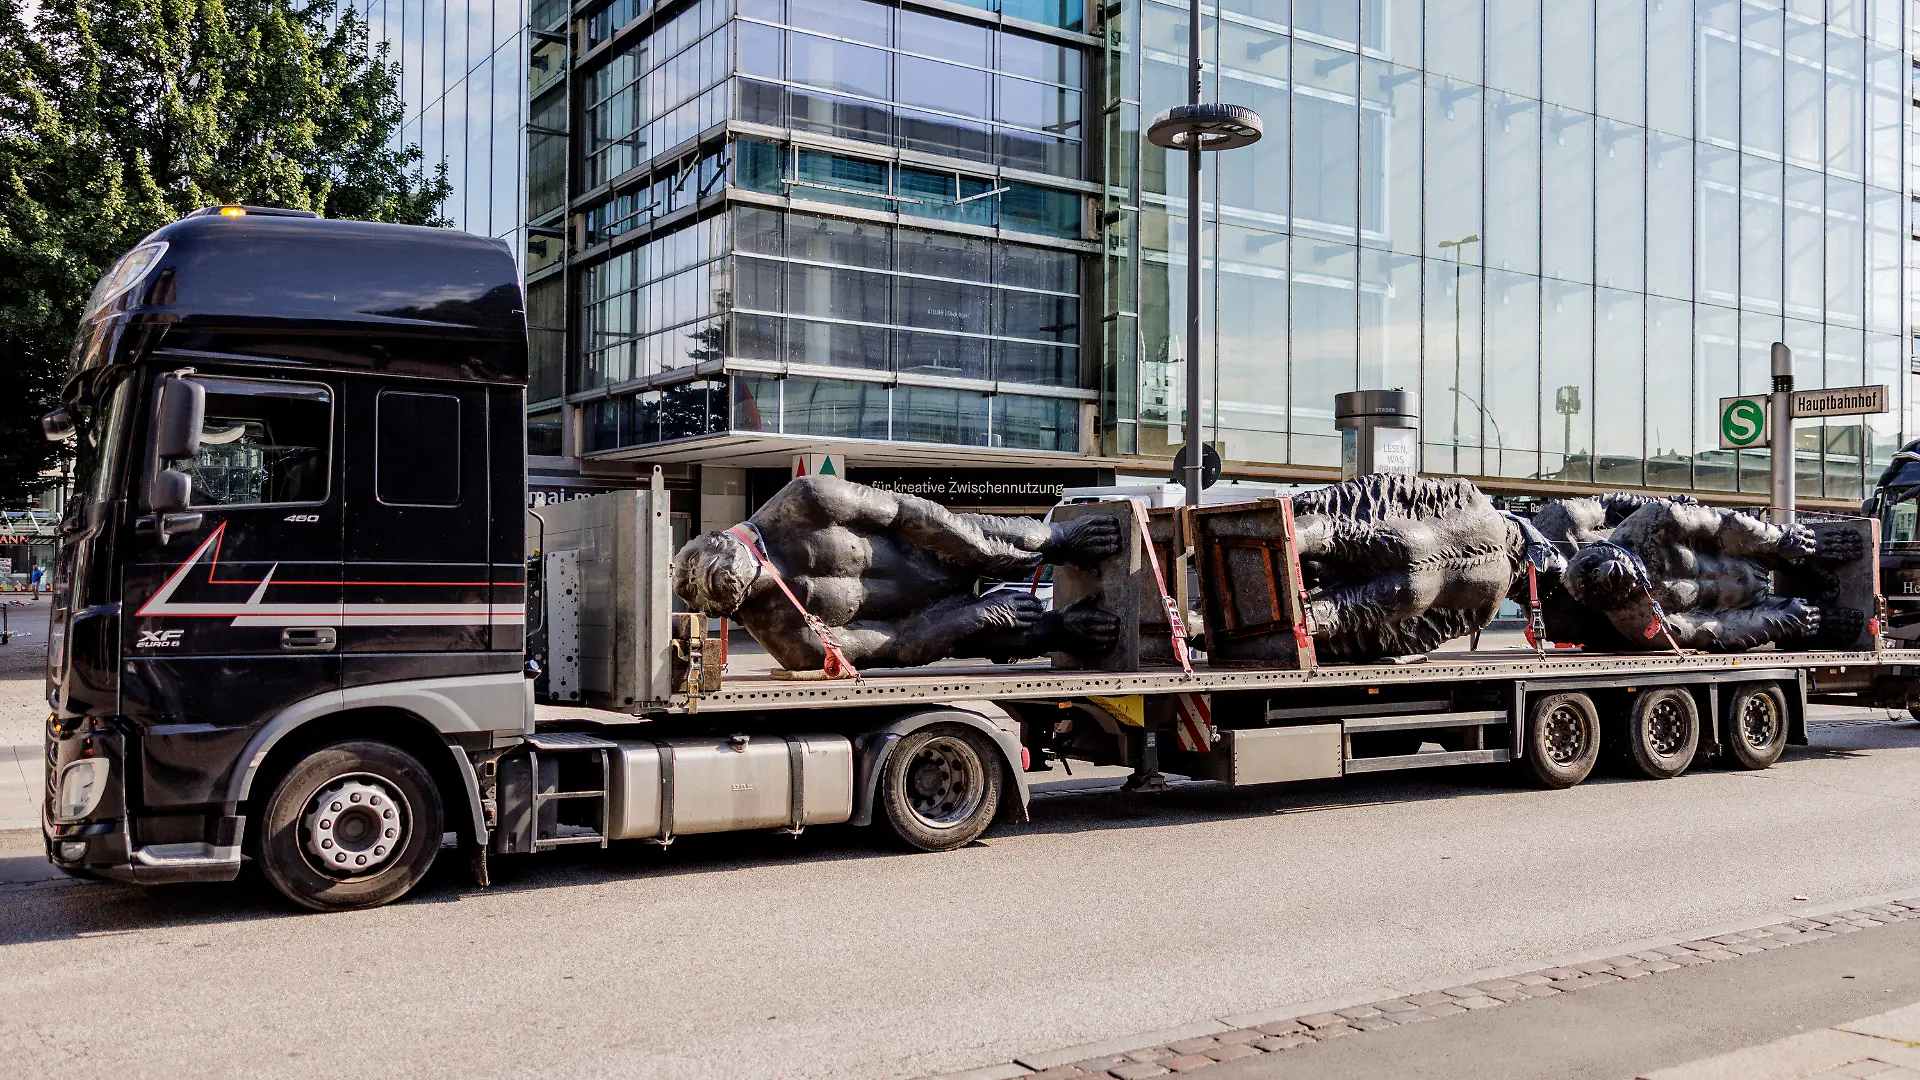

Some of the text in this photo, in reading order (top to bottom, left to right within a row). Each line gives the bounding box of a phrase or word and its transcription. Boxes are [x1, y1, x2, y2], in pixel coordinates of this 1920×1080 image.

[1798, 391, 1877, 413] Hauptbahnhof
[1730, 405, 1756, 440] S
[1383, 443, 1408, 455] LESEN,
[1387, 455, 1405, 464] WAS
[893, 480, 945, 493] kreative
[948, 481, 1064, 497] Zwischennutzung
[283, 514, 320, 522] 460
[138, 629, 185, 642] XF
